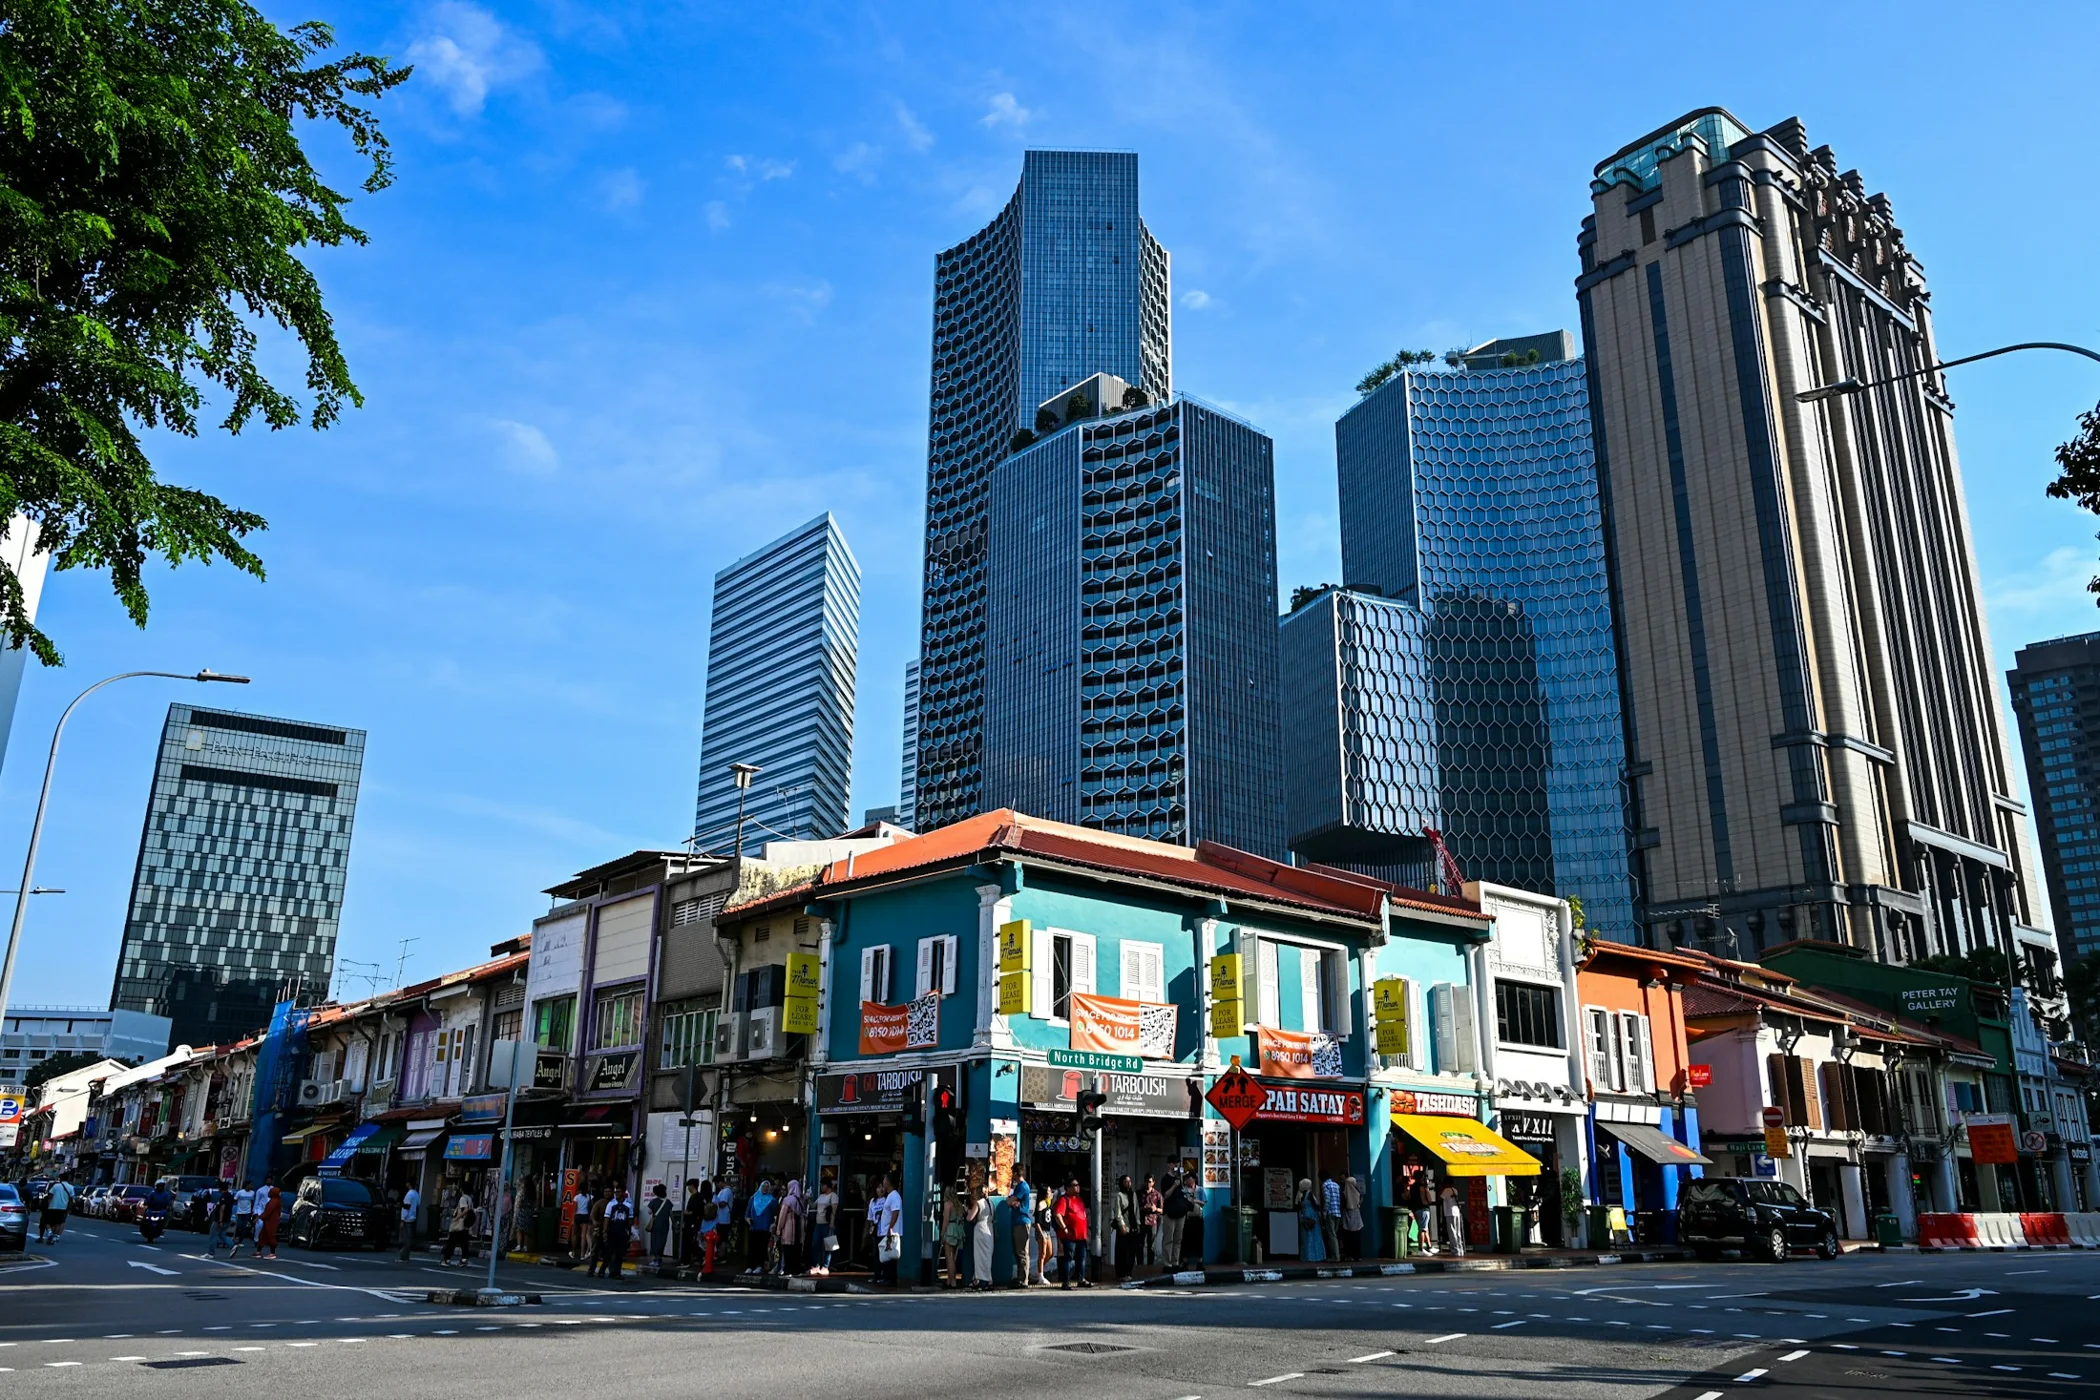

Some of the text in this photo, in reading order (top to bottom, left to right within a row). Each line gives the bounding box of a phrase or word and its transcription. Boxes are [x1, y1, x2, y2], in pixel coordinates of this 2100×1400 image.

[211, 740, 312, 766] PAN PACIFIC
[1005, 981, 1017, 991] FOR
[1002, 990, 1020, 1000] LEASE
[1902, 987, 1958, 1000] PETER TAY
[796, 1005, 809, 1014] FOR
[1907, 999, 1957, 1011] GALLERY
[791, 1012, 813, 1021] LEASE
[1218, 1009, 1231, 1017] FOR
[1215, 1017, 1235, 1025] LEASE
[1114, 1026, 1136, 1040] 1014
[1382, 1028, 1394, 1036] FOR
[1054, 1052, 1138, 1070] North Bridge Rd
[1271, 1050, 1309, 1064] 8950 1014
[535, 1060, 562, 1083] Angel
[600, 1057, 627, 1080] Angel
[1110, 1074, 1167, 1096] TARBOUSH
[1219, 1096, 1257, 1109] MERGE
[1300, 1092, 1345, 1116] SATAY
[1416, 1092, 1478, 1117] TASHDASH
[1730, 1143, 1766, 1152] Haji Lane
[560, 1172, 575, 1240] SALE
